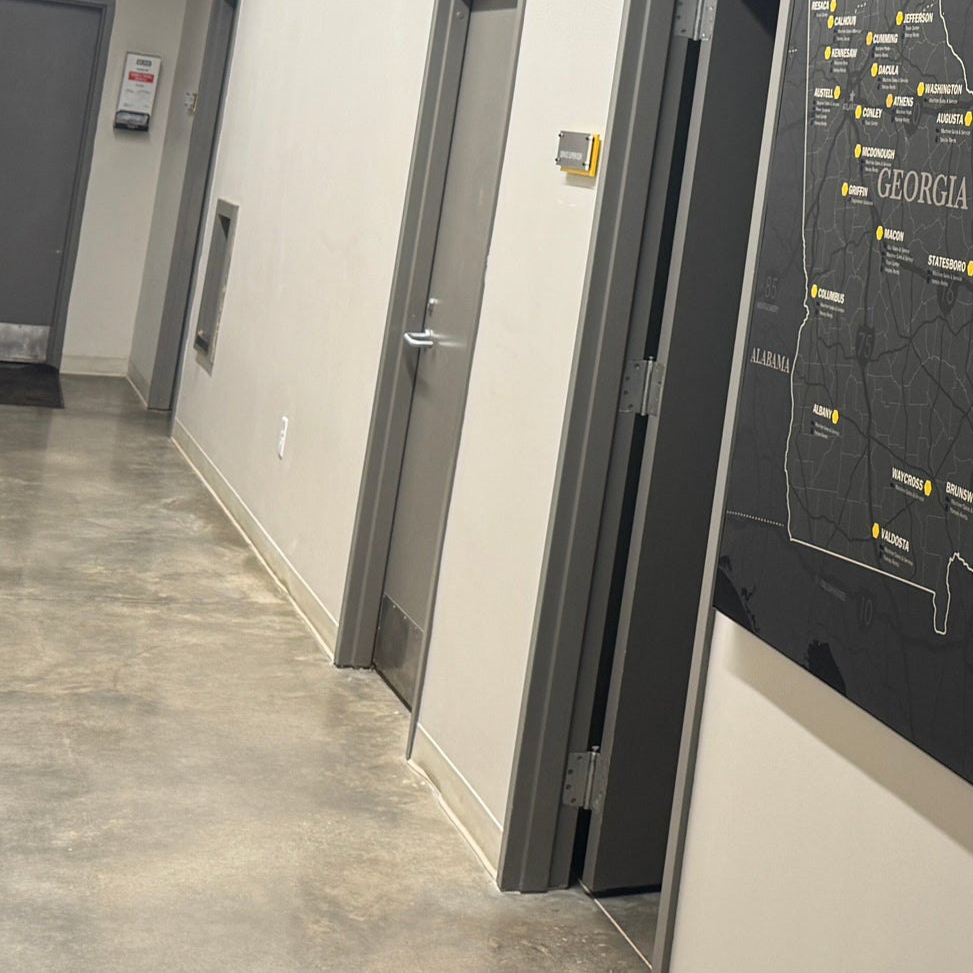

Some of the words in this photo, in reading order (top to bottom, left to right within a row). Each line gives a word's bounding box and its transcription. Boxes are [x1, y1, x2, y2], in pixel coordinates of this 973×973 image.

[834, 15, 857, 26] CALHOUN
[903, 13, 934, 24] JEFFERSON
[873, 33, 898, 44] CUMMING
[831, 48, 858, 59] KENNESAW
[877, 65, 899, 76] DACULA
[813, 87, 834, 99] AUSTELL
[924, 83, 963, 95] WASHINGTON
[892, 96, 914, 107] ATHENS
[862, 107, 883, 118] CONLEY
[936, 113, 964, 125] AUGUSTA
[861, 146, 896, 160] MCDONOUGH
[848, 185, 868, 198] GRIFFIN
[877, 167, 969, 210] GEORGIA
[883, 228, 905, 242] MACON
[927, 254, 967, 273] STATESBORO
[817, 288, 845, 304] COLUMBUS
[750, 347, 790, 373] ALABAMA
[812, 403, 832, 419] ALBANY
[891, 467, 924, 491] WAYCROSS
[880, 528, 910, 553] VALDOSTA
